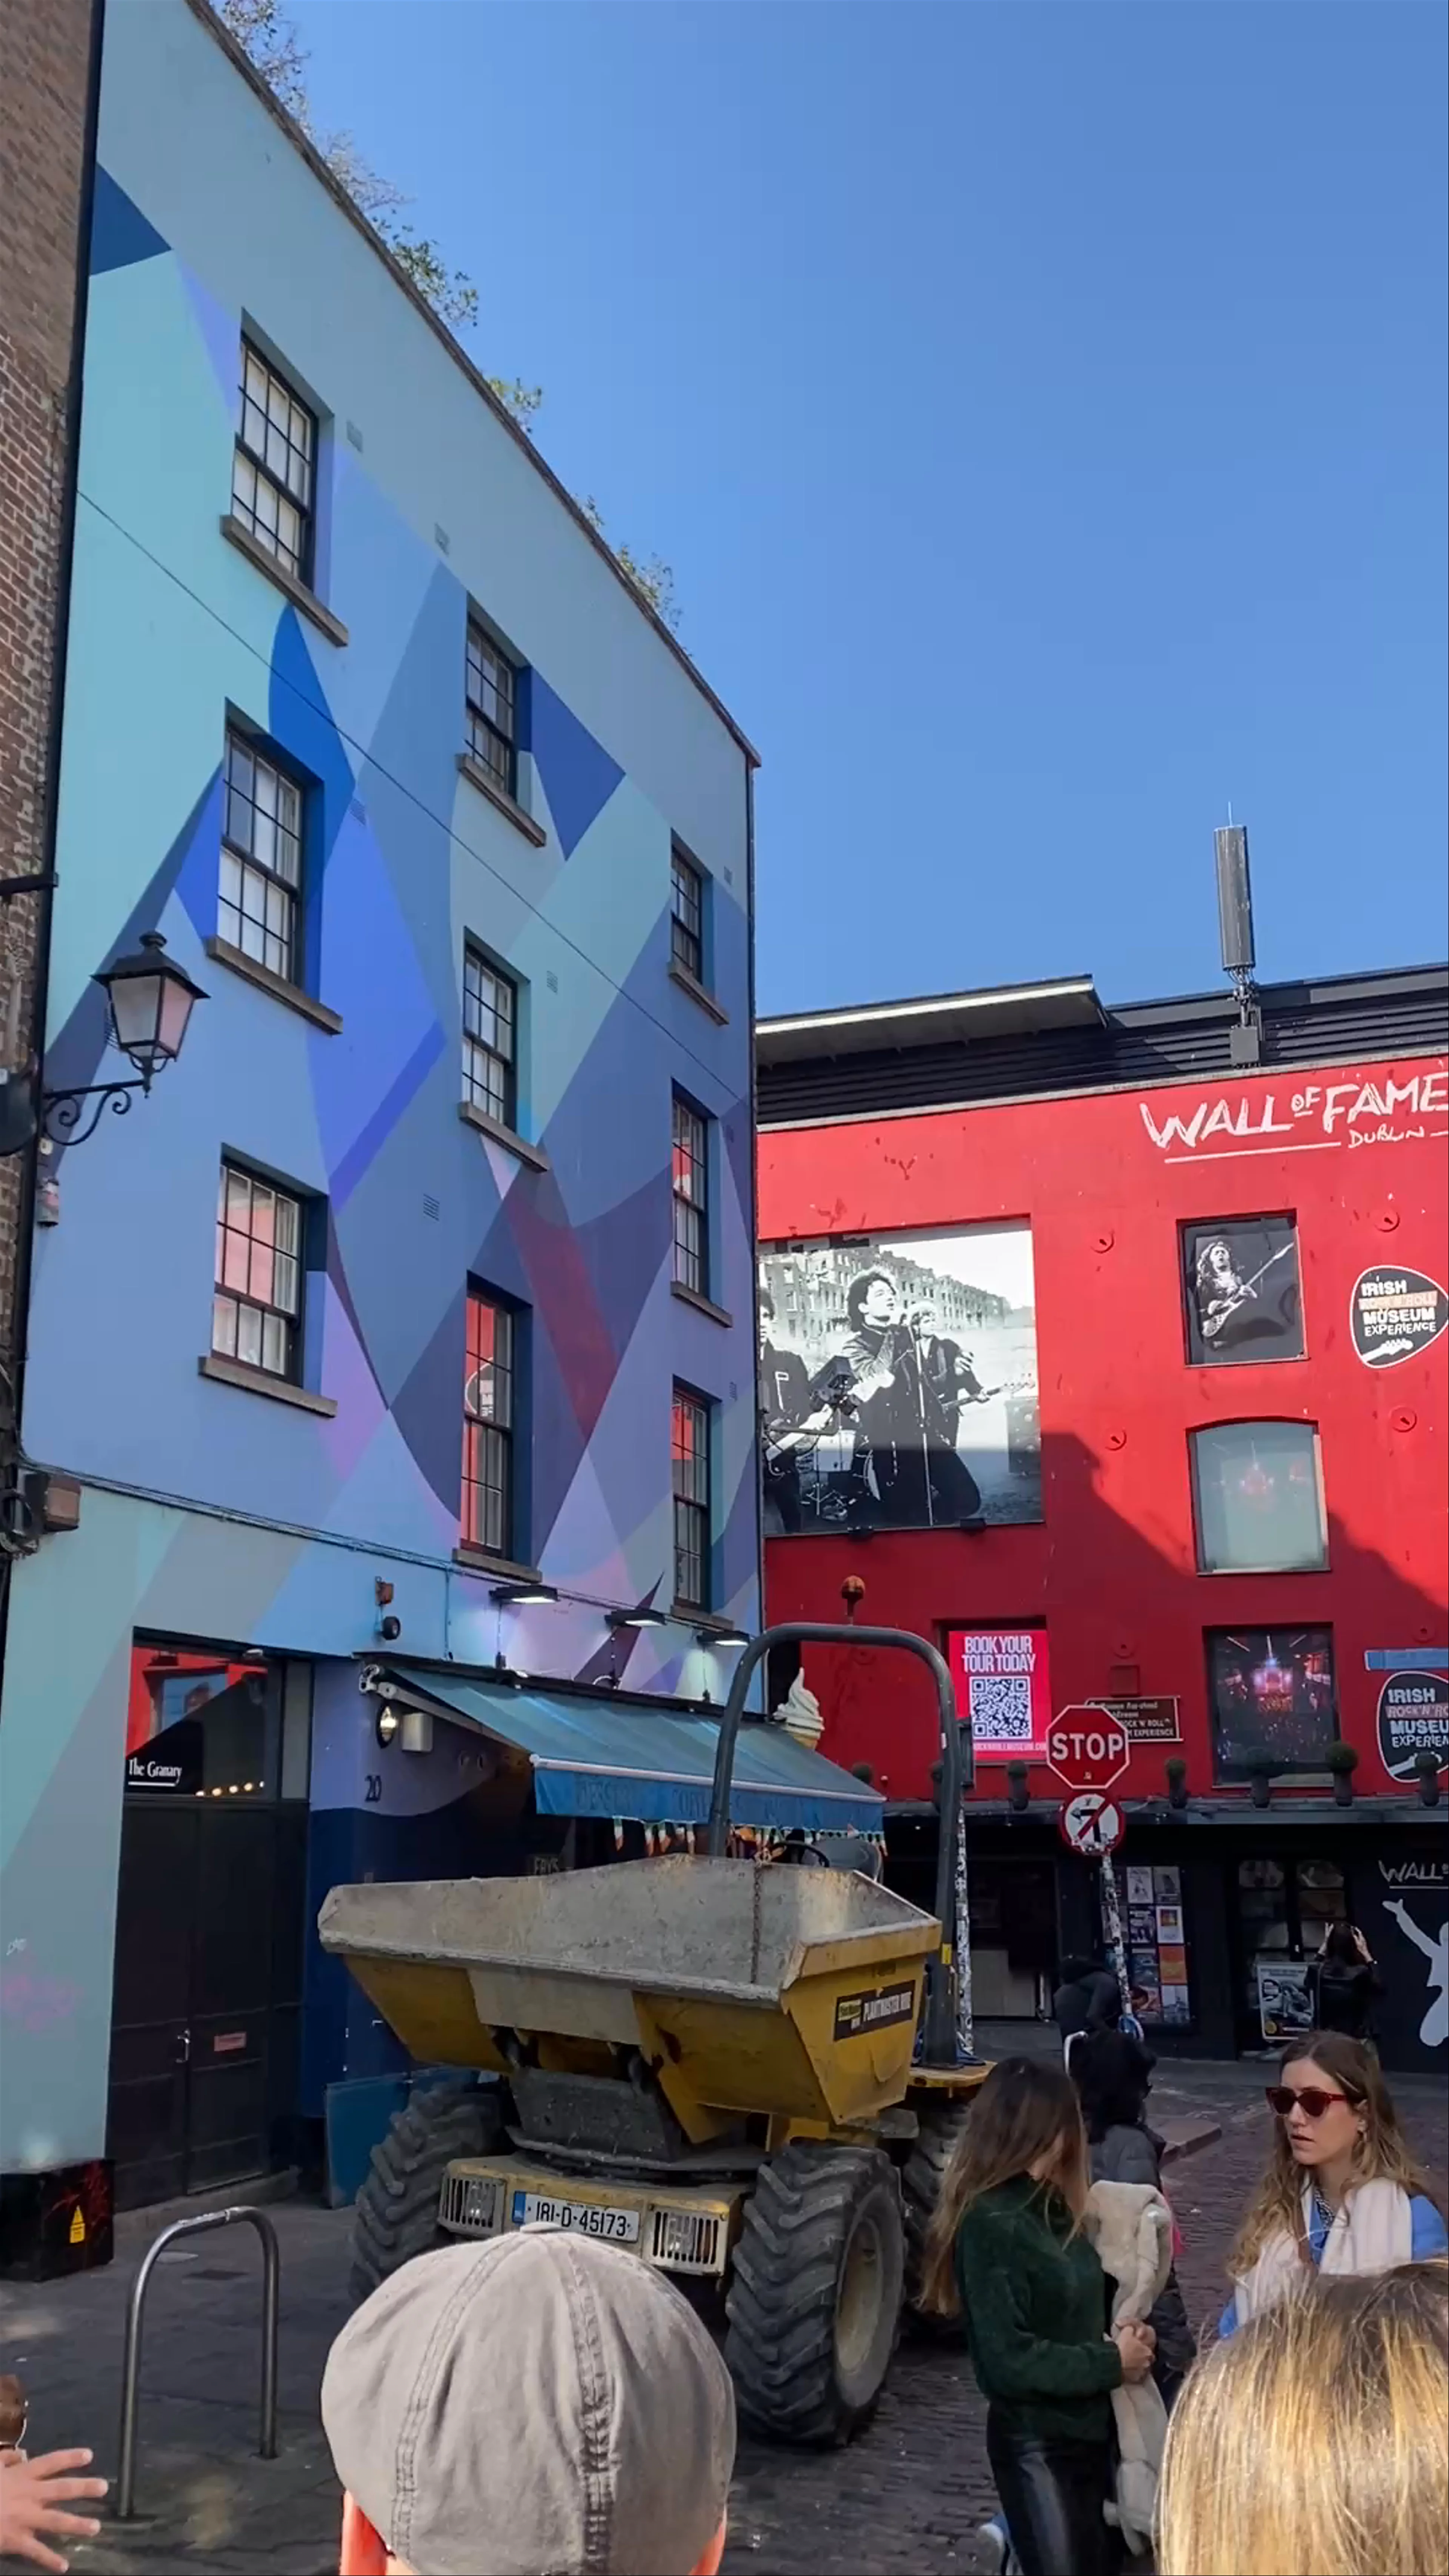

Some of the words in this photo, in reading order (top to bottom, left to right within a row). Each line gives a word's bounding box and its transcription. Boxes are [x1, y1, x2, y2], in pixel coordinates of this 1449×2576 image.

[1139, 1094, 1294, 1148] WALL
[1291, 1087, 1322, 1112] OF
[1323, 1071, 1448, 1133] FAME
[1348, 1123, 1424, 1148] DUBLIN
[1361, 1279, 1407, 1296] IRISH
[1363, 1307, 1435, 1325] MUSEUM
[1364, 1321, 1437, 1336] EXPERIENCE
[965, 1636, 998, 1653] BOOK
[998, 1635, 1033, 1653] YOUR
[961, 1654, 994, 1672] TOUR
[995, 1653, 1036, 1672] TODAY
[1387, 1688, 1435, 1704] IRISH
[1386, 1704, 1448, 1718] ROCK'N'RO
[1134, 1728, 1174, 1737] EXPERIENCE
[1389, 1719, 1448, 1735] MUSEU
[1051, 1733, 1123, 1760] STOP
[1391, 1735, 1448, 1748] EXPERIEN
[128, 1757, 145, 1776] The
[147, 1761, 182, 1784] Granary
[365, 1775, 382, 1803] 20
[1378, 1859, 1444, 1883] WALL
[535, 2201, 627, 2237] 181-D-45173
